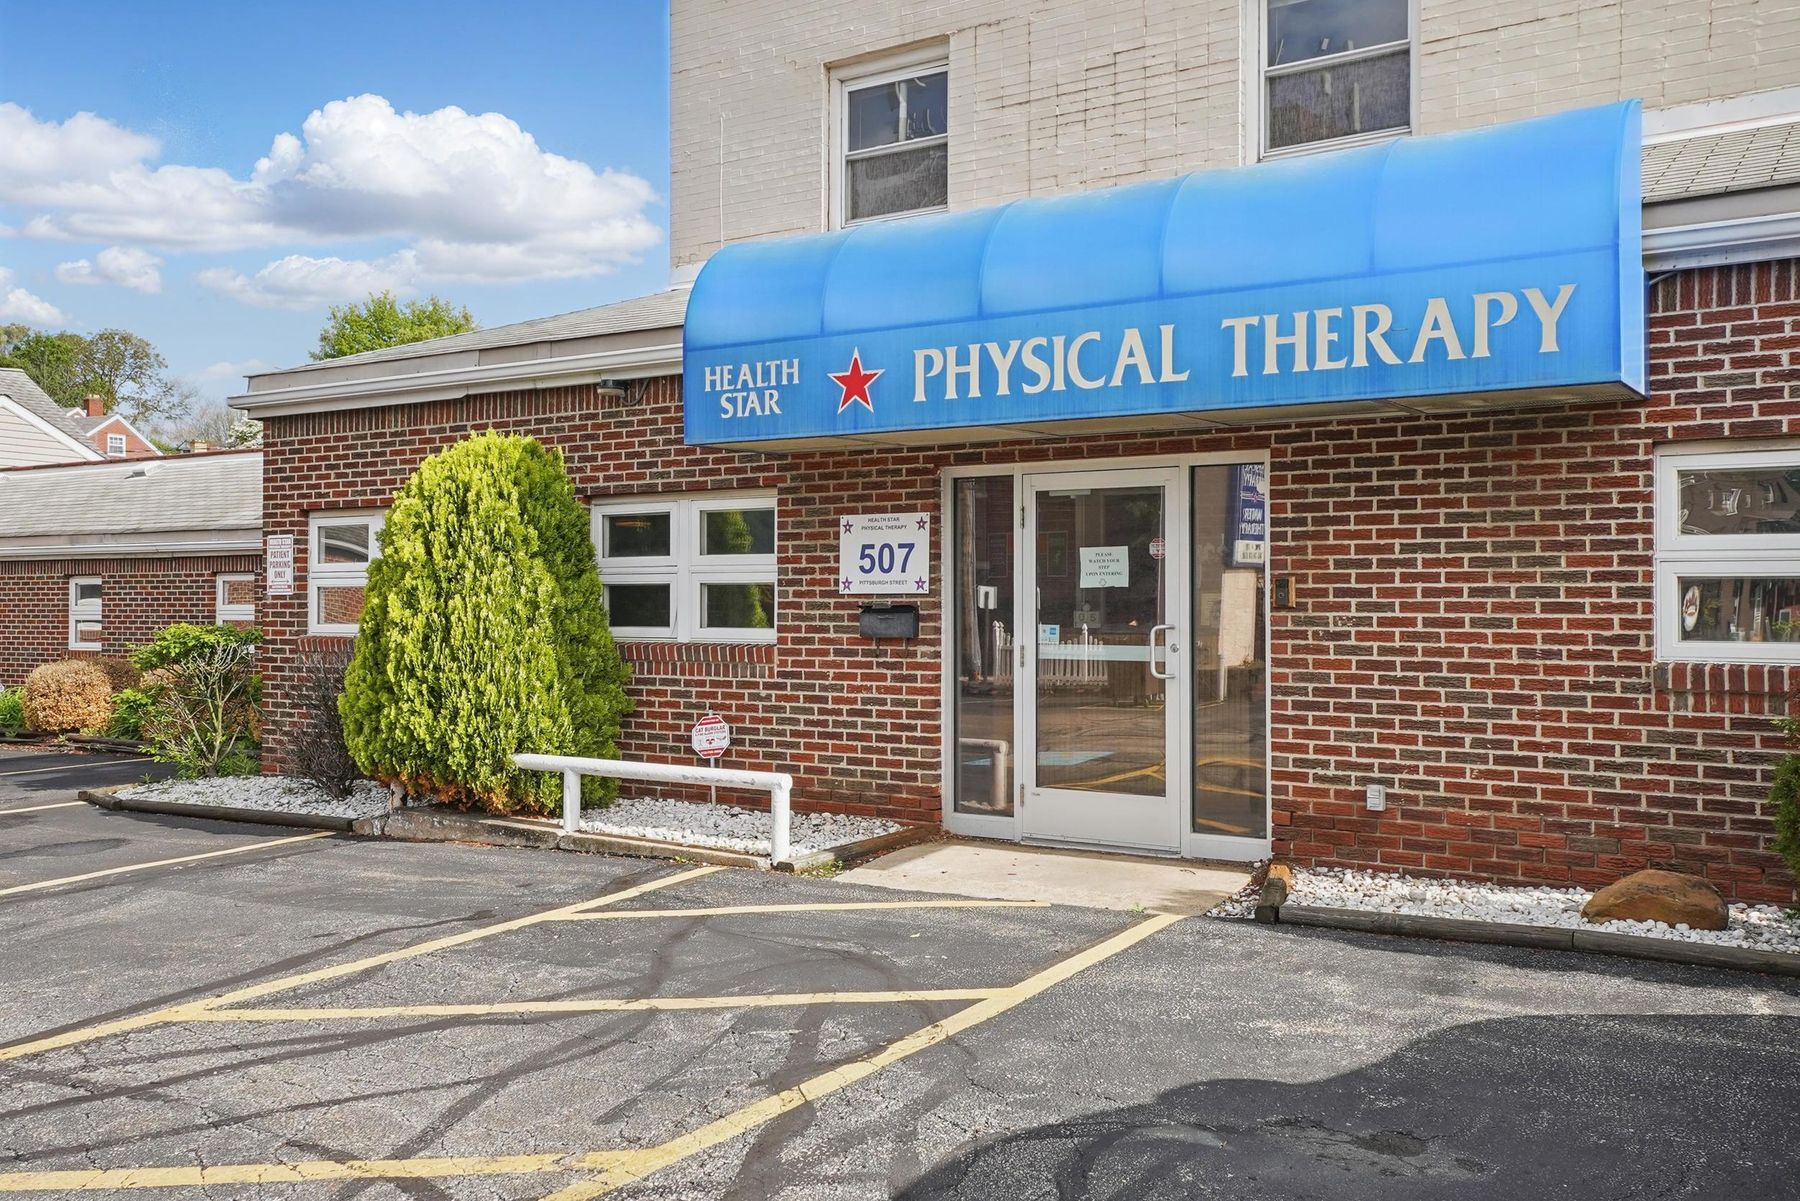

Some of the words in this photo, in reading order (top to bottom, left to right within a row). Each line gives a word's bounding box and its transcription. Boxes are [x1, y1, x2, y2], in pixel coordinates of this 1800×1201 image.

[913, 324, 1191, 402] PHYSICAL
[1220, 283, 1577, 377] THERAPY
[704, 358, 800, 392] HEALTH
[720, 389, 782, 419] STAR
[269, 560, 291, 569] PARKING
[270, 550, 290, 559] PATIENT
[858, 543, 915, 574] 507
[273, 571, 286, 579] ONLY
